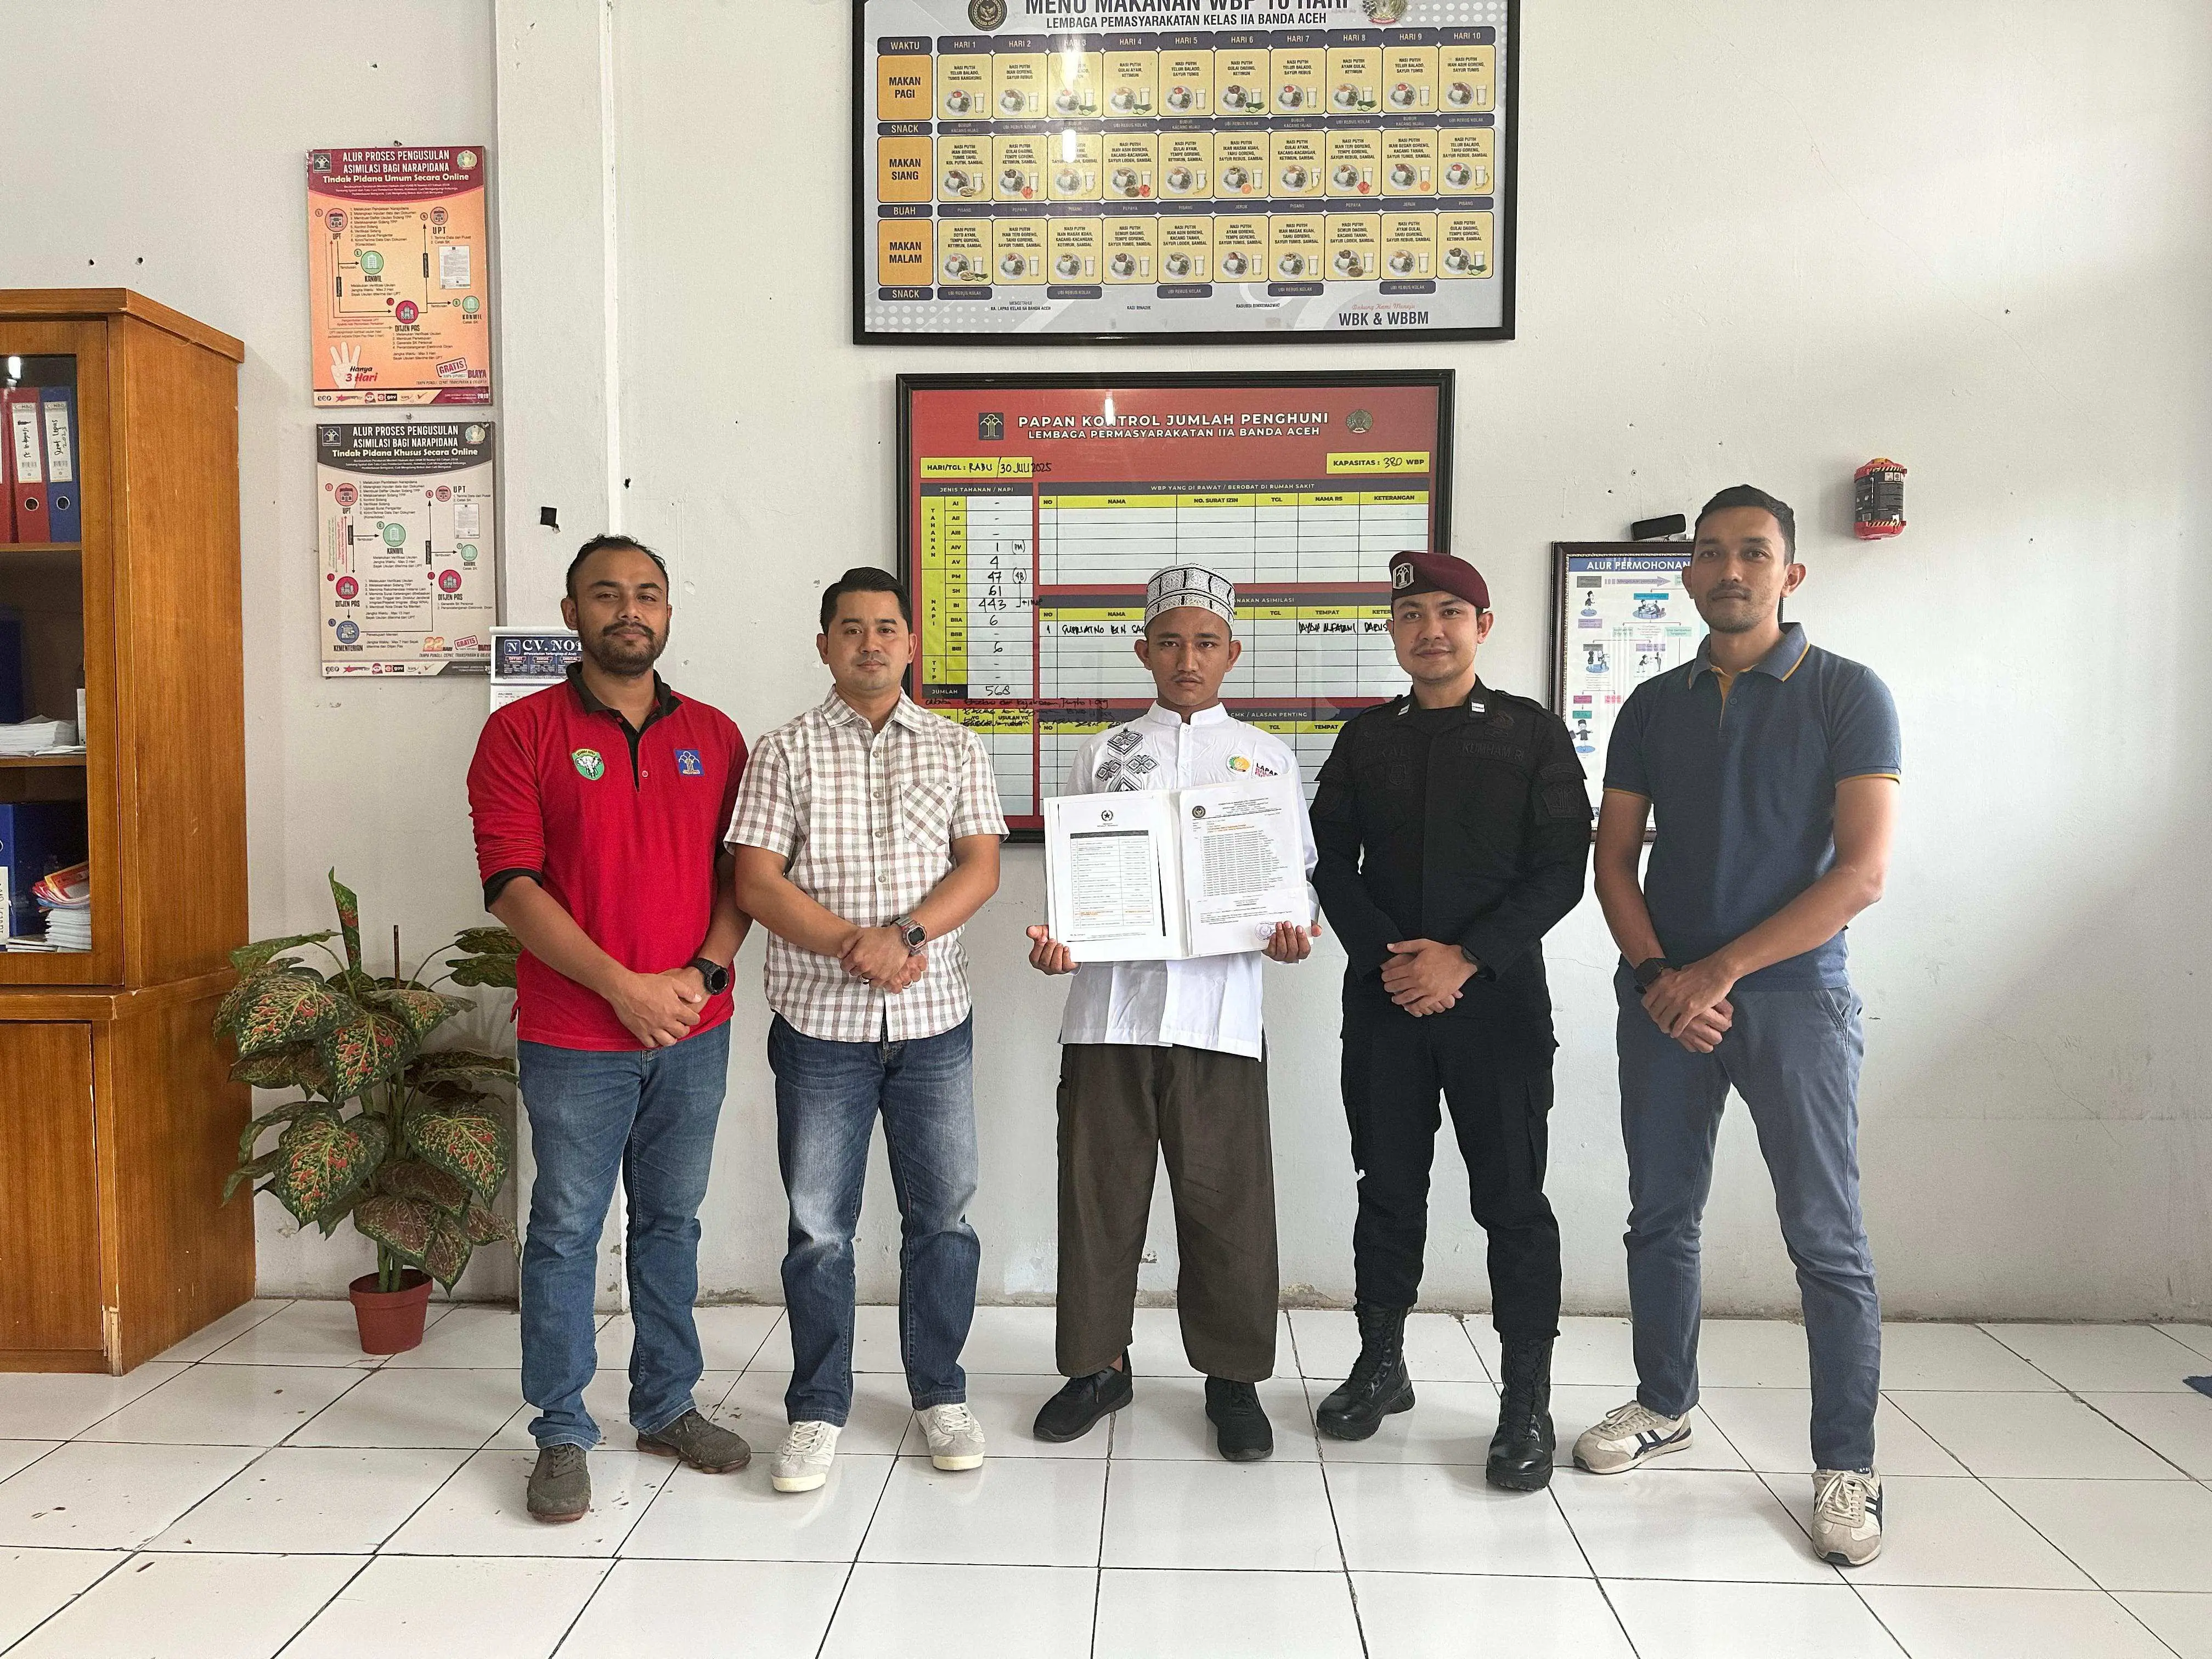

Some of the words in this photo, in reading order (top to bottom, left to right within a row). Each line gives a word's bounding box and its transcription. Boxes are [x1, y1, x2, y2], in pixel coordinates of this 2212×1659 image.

[1026, 0, 1086, 14] MENU
[1095, 0, 1200, 13] MAKANAN
[1047, 17, 1097, 28] LEMBAGA
[1101, 15, 1200, 27] PEMASYARAKATAN
[1204, 14, 1237, 25] KELAS
[1241, 13, 1255, 25] IIA
[1259, 13, 1295, 24] BANDA
[1297, 13, 1327, 24] ACEH
[890, 41, 920, 50] WAKTU
[889, 77, 921, 86] MAKAN
[895, 89, 915, 98] PAGI
[891, 125, 918, 133] SNACK
[343, 152, 363, 162] ALUR
[365, 151, 396, 161] PROSES
[398, 150, 449, 161] PENGUSULAN
[343, 163, 381, 174] ASIMILASI
[383, 162, 400, 173] BAGI
[402, 162, 449, 172] NARAPIDANA
[889, 159, 921, 167] MAKAN
[891, 172, 919, 180] SIANG
[894, 207, 916, 215] BUAH
[889, 242, 922, 251] MAKAN
[889, 255, 922, 263] MALAM
[892, 290, 919, 298] SNACK
[1339, 312, 1369, 325] WBK
[1373, 312, 1382, 325] &
[1387, 311, 1429, 324] WBBM
[438, 360, 465, 375] GRATIS
[345, 374, 352, 382] 3
[357, 373, 379, 382] Hari
[1018, 416, 1075, 427] PAPAN
[1082, 415, 1160, 426] KONTROL
[1166, 414, 1234, 426] JUMLAH
[1240, 413, 1329, 425] PENGHUNI
[353, 427, 373, 437] ALUR
[375, 426, 405, 436] PROSES
[407, 425, 459, 436] PENGUSULAN
[1029, 430, 1086, 438] LEMBAGA
[1091, 428, 1214, 438] PERMASYARAKATAN
[1218, 428, 1235, 437] IIA
[1239, 427, 1283, 436] BANDA
[1286, 426, 1320, 435] ACEH
[353, 438, 391, 448] ASIMILASI
[393, 438, 410, 448] BAGI
[412, 437, 458, 447] NARAPIDANA
[969, 462, 992, 472] RABU
[1031, 462, 1052, 472] 2025
[1383, 458, 1403, 469] 380
[990, 556, 1000, 569] 4
[1587, 561, 1611, 570] ALUR
[1615, 561, 1690, 569] PERMOHONAN
[988, 572, 1002, 584] 47
[988, 585, 1001, 596] 61
[978, 599, 1006, 613] 443
[990, 614, 998, 626] 6
[423, 636, 445, 652] 22
[507, 642, 518, 652] N
[522, 639, 548, 651] CV.
[993, 641, 1003, 653] 6
[985, 685, 1011, 696] 568
